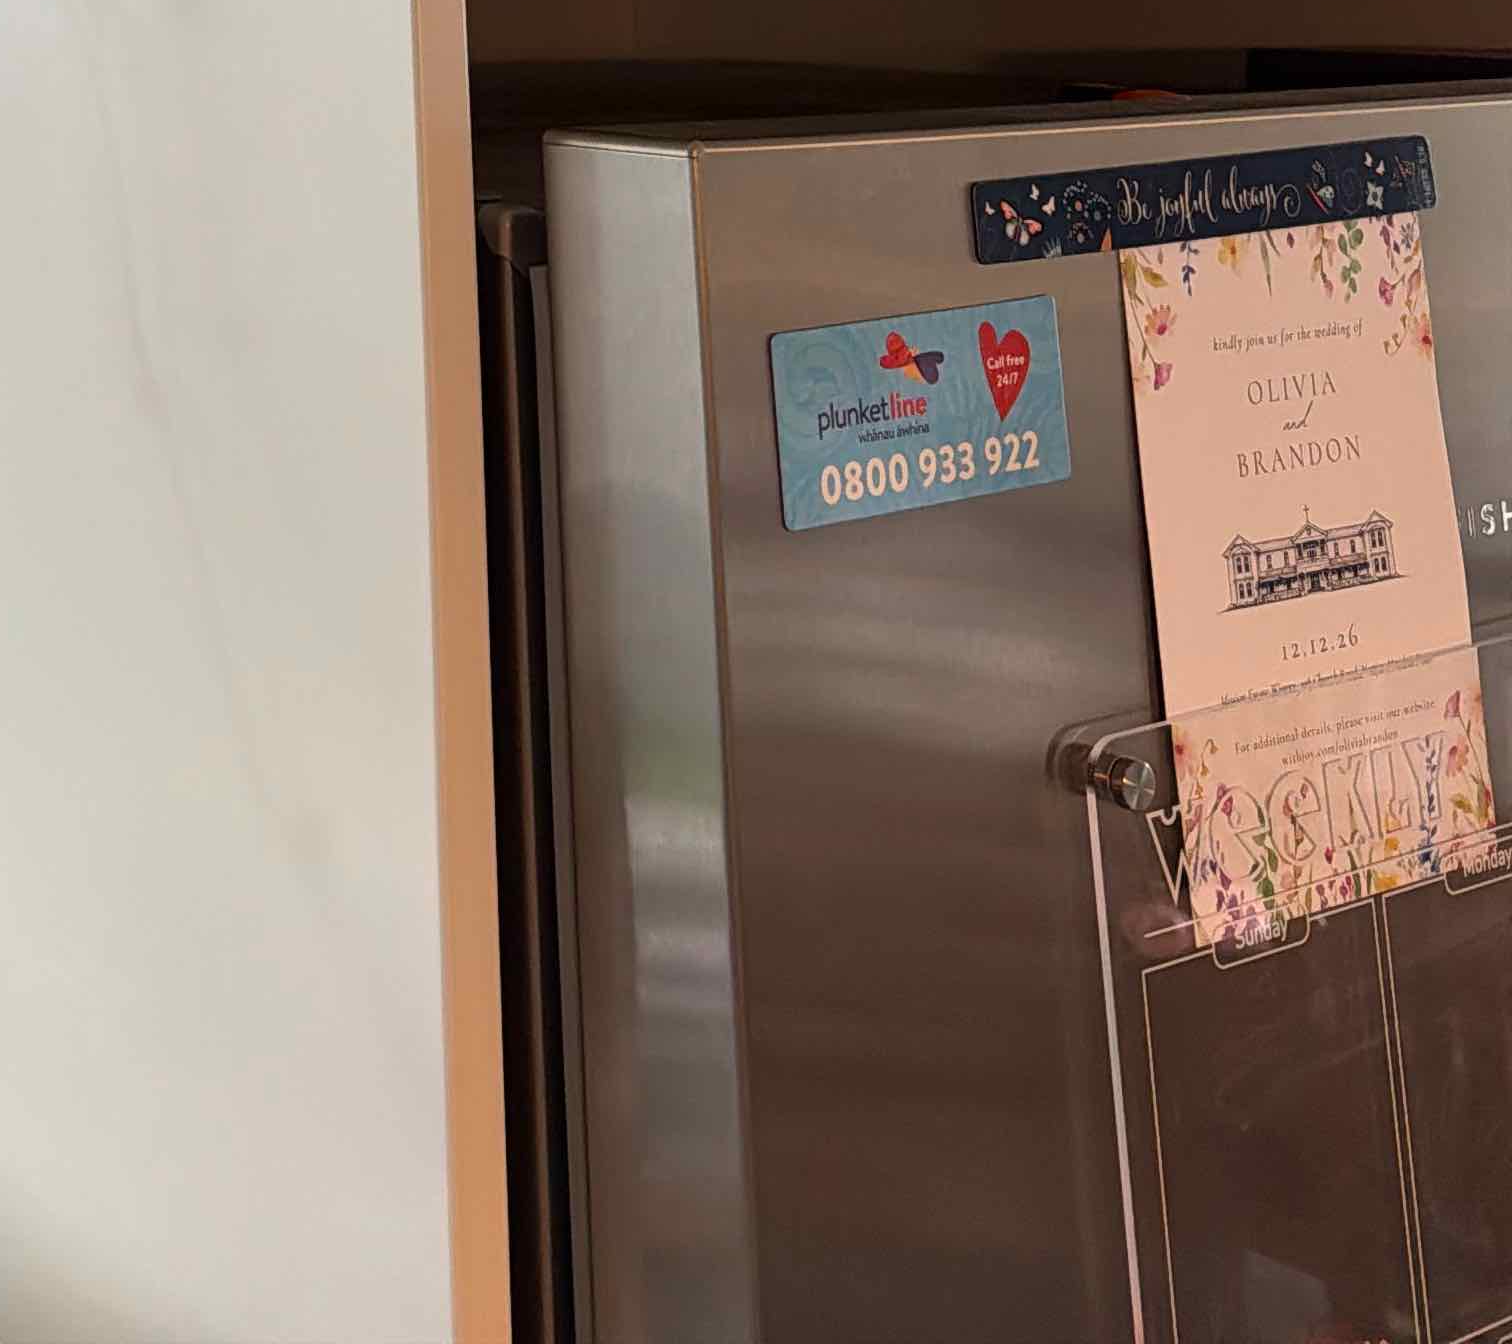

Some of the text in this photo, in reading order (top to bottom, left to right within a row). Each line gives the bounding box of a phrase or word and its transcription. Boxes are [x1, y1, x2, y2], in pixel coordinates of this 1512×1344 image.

[1117, 165, 1301, 239] Be joyful always
[1213, 318, 1363, 353] kindly join us for the wedding of
[987, 353, 1026, 371] Call free
[996, 372, 1019, 388] 24/7
[1247, 371, 1336, 405] OLIVIA
[818, 391, 928, 440] plunketline
[1282, 399, 1314, 431] and
[820, 430, 1040, 506] 0800 933 922
[1236, 433, 1361, 478] BRANDON
[1281, 622, 1359, 661] 12.12.26
[1235, 742, 1251, 755] For
[1253, 727, 1299, 751] additional
[1336, 715, 1364, 733] please
[1462, 847, 1512, 878] Monday
[1234, 914, 1289, 950] Sunday
